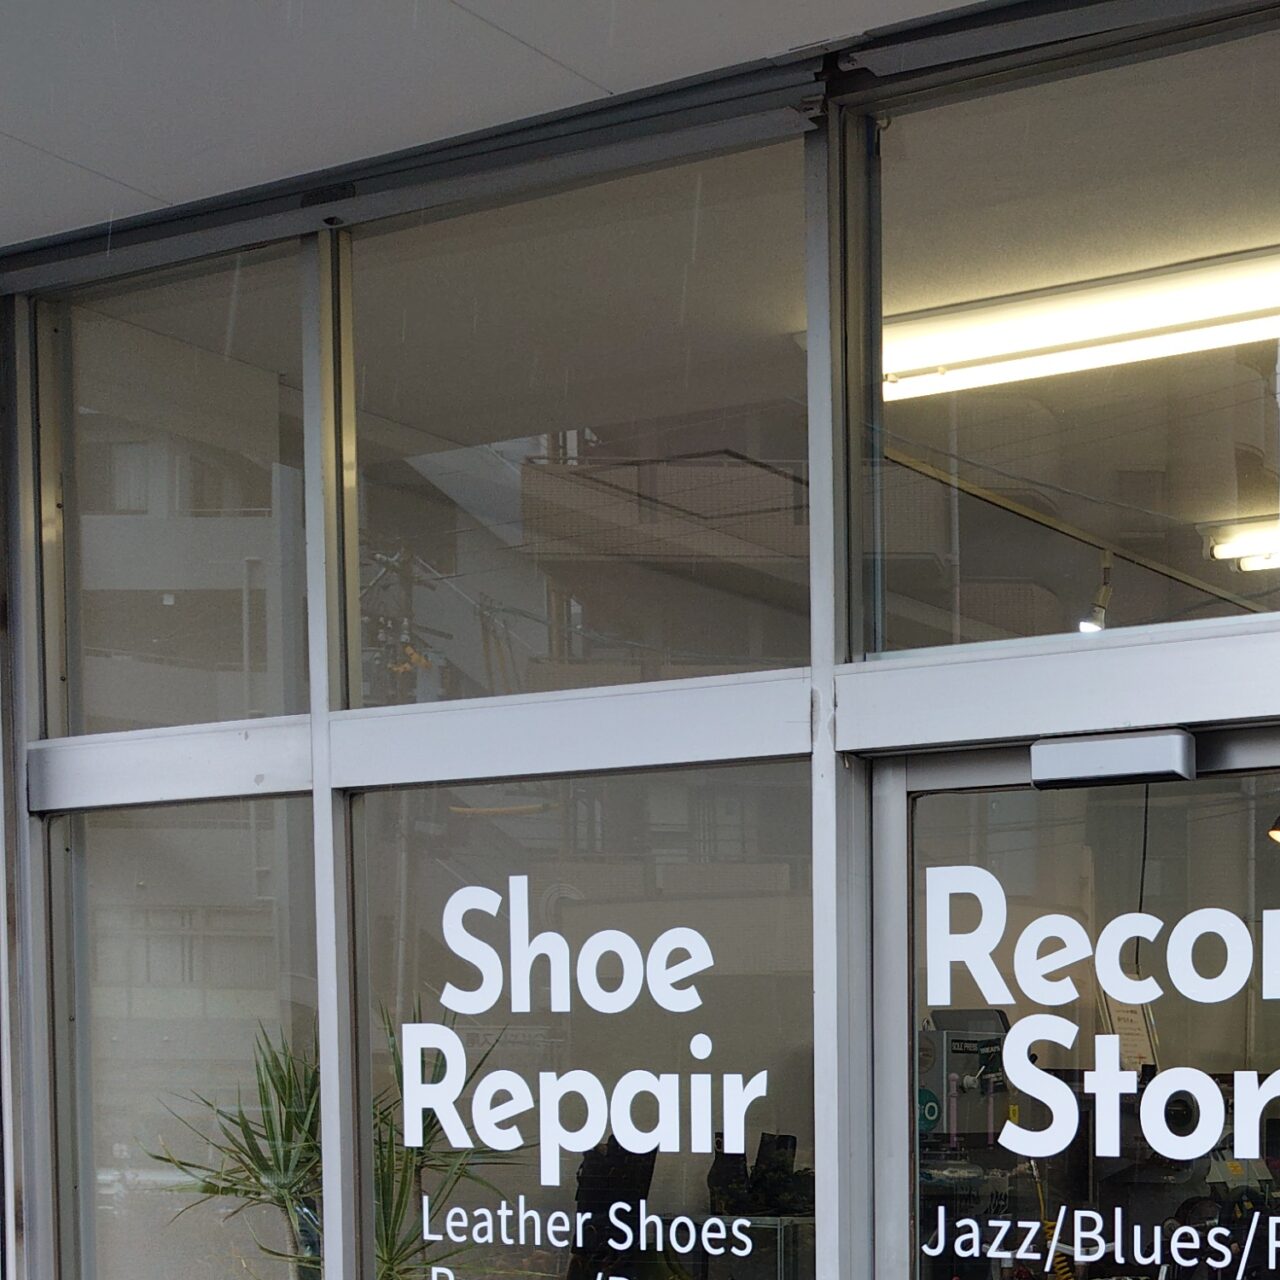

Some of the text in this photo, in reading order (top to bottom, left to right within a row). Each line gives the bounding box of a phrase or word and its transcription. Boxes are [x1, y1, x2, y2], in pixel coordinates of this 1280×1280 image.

[440, 874, 714, 1014] Shoe
[402, 1022, 767, 1186] Repair
[423, 1195, 752, 1256] Leather Shoes
